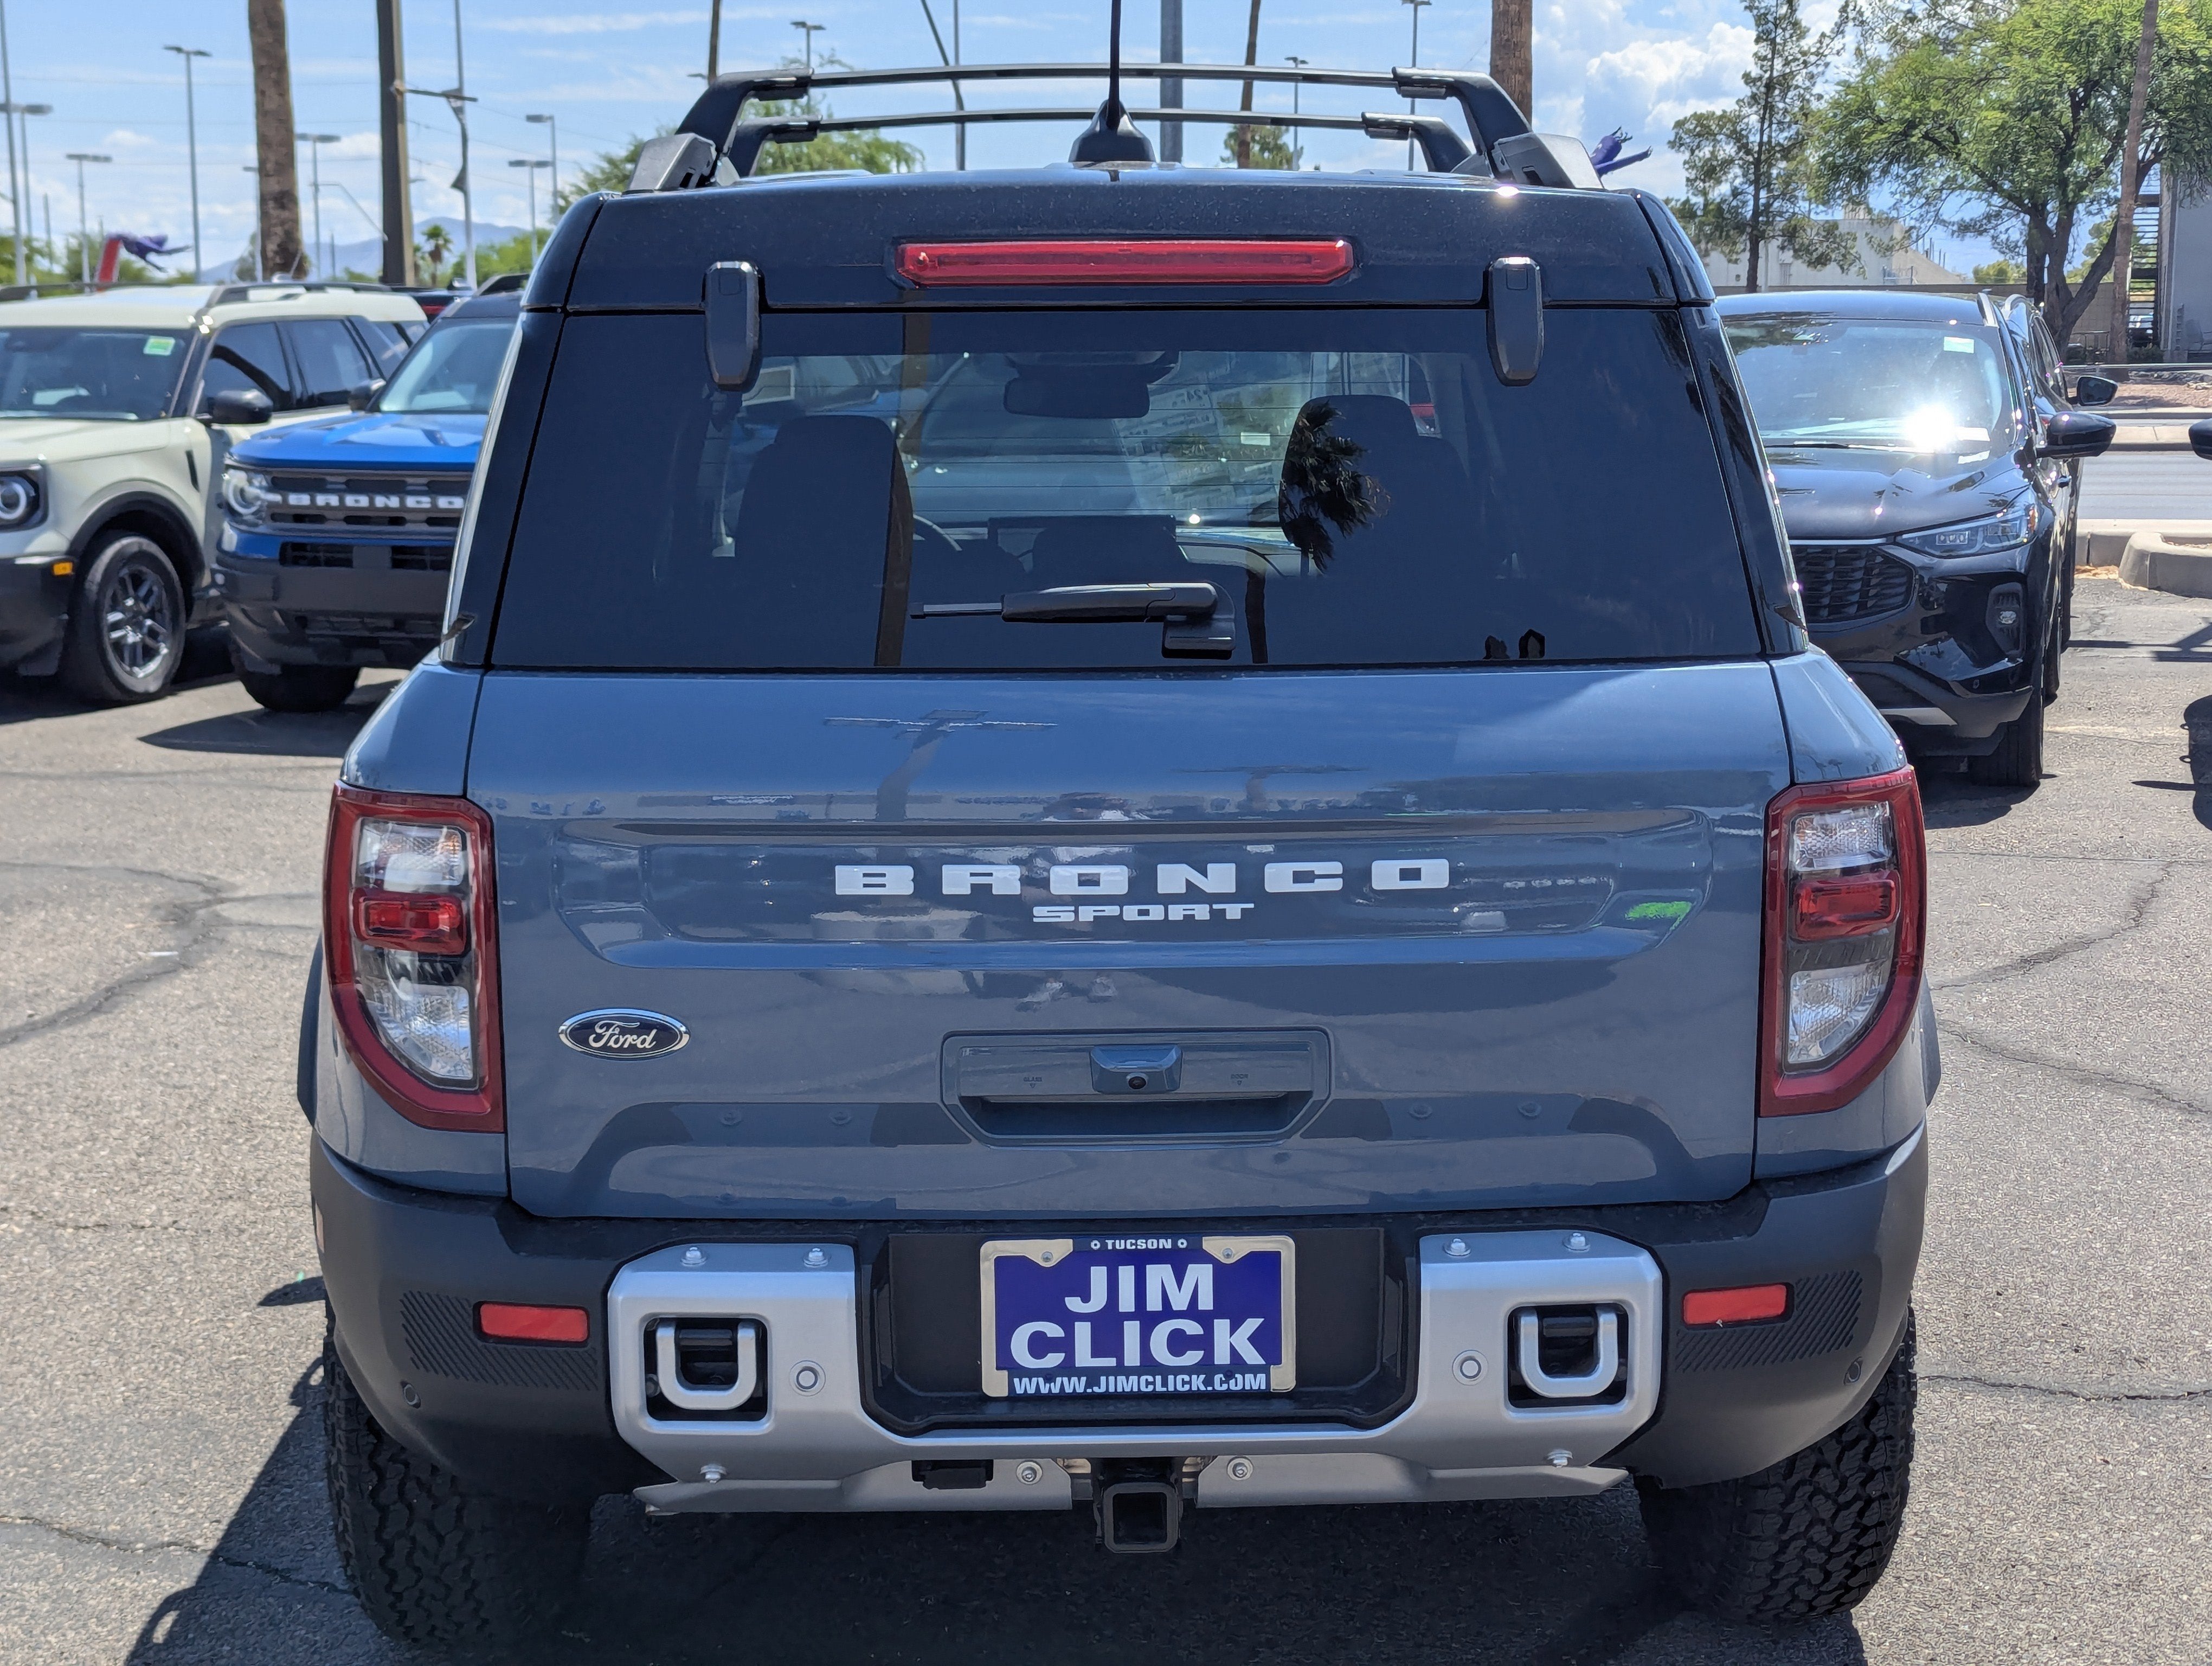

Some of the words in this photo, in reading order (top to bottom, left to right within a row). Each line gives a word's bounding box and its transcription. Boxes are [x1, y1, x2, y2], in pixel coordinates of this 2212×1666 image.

[288, 492, 465, 509] BRONCO
[835, 858, 1449, 895] BRONCO
[1032, 903, 1255, 922] SPORT
[588, 1020, 658, 1048] Ford
[1105, 1239, 1172, 1250] TUCSON
[1065, 1264, 1213, 1313] JIM
[1011, 1318, 1266, 1368] CLICK
[1013, 1373, 1266, 1394] WWW.JIMCLICK.COM
